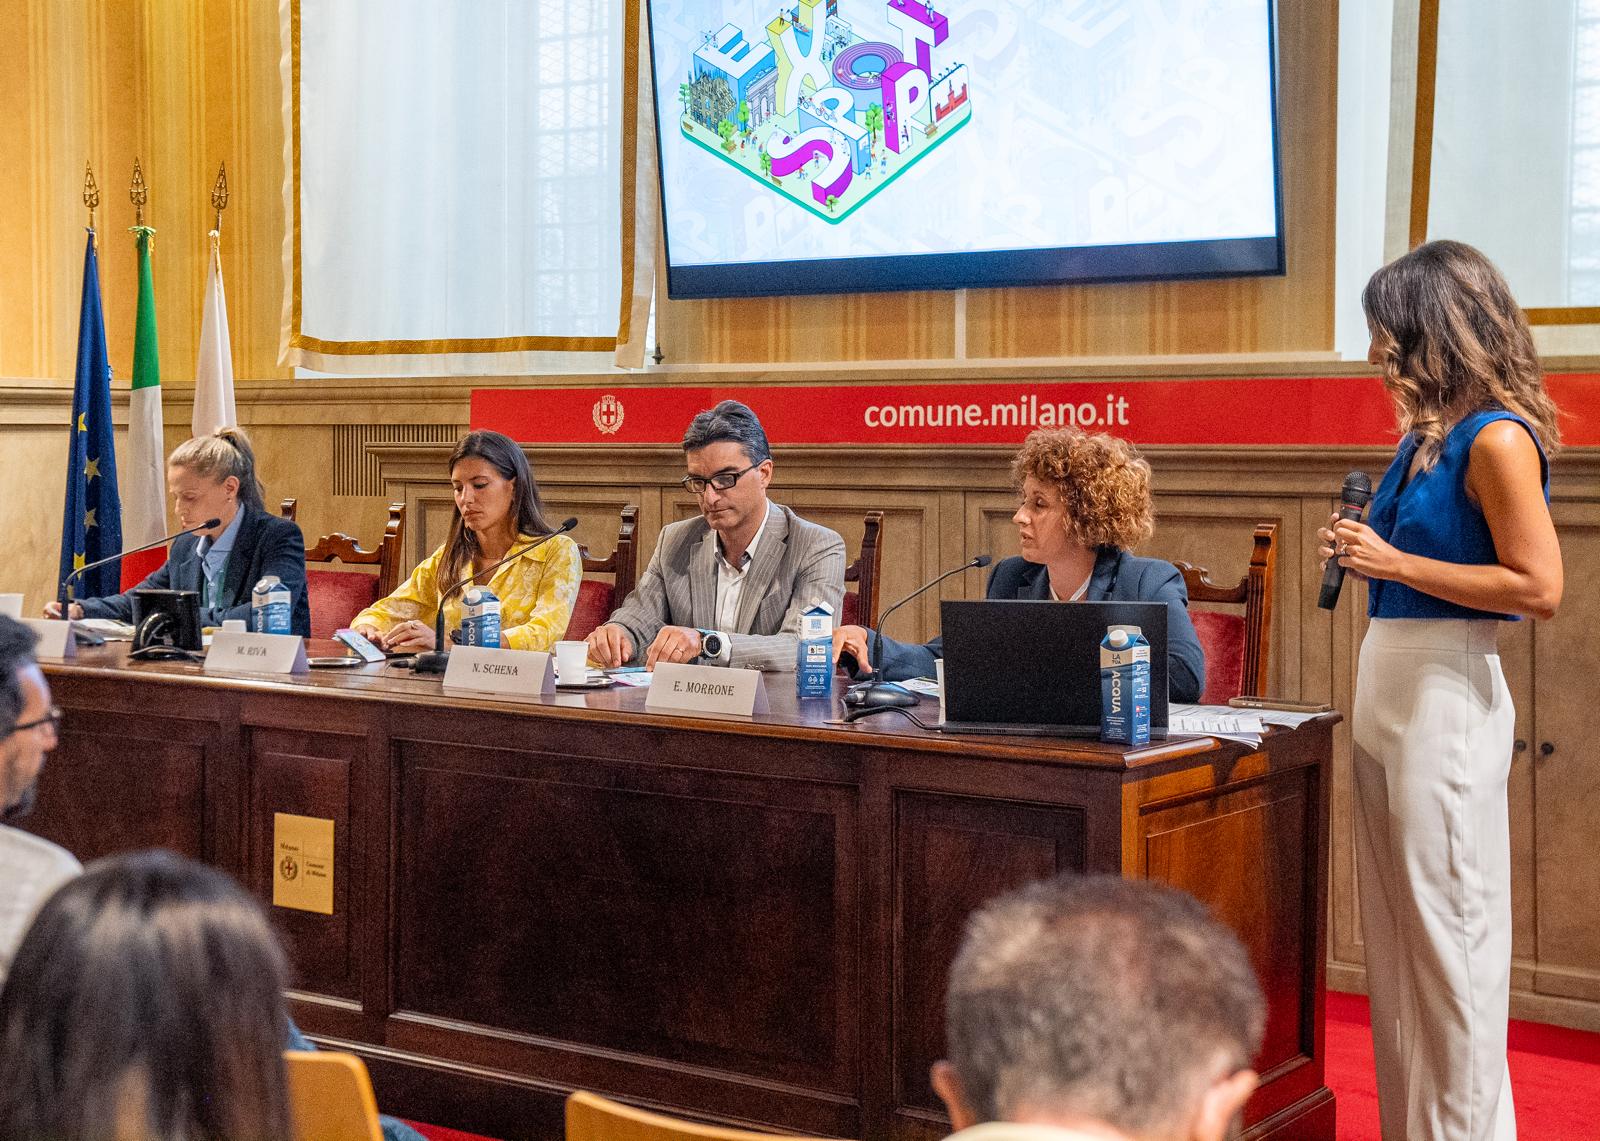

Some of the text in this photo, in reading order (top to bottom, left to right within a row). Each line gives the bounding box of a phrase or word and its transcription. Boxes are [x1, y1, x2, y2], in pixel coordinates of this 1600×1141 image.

[864, 394, 1129, 427] comune.milano.it
[247, 646, 266, 656] RIVA
[472, 663, 519, 676] N. SCHENA
[674, 680, 735, 696] E. MORRONE
[1112, 670, 1121, 714] ACQUA
